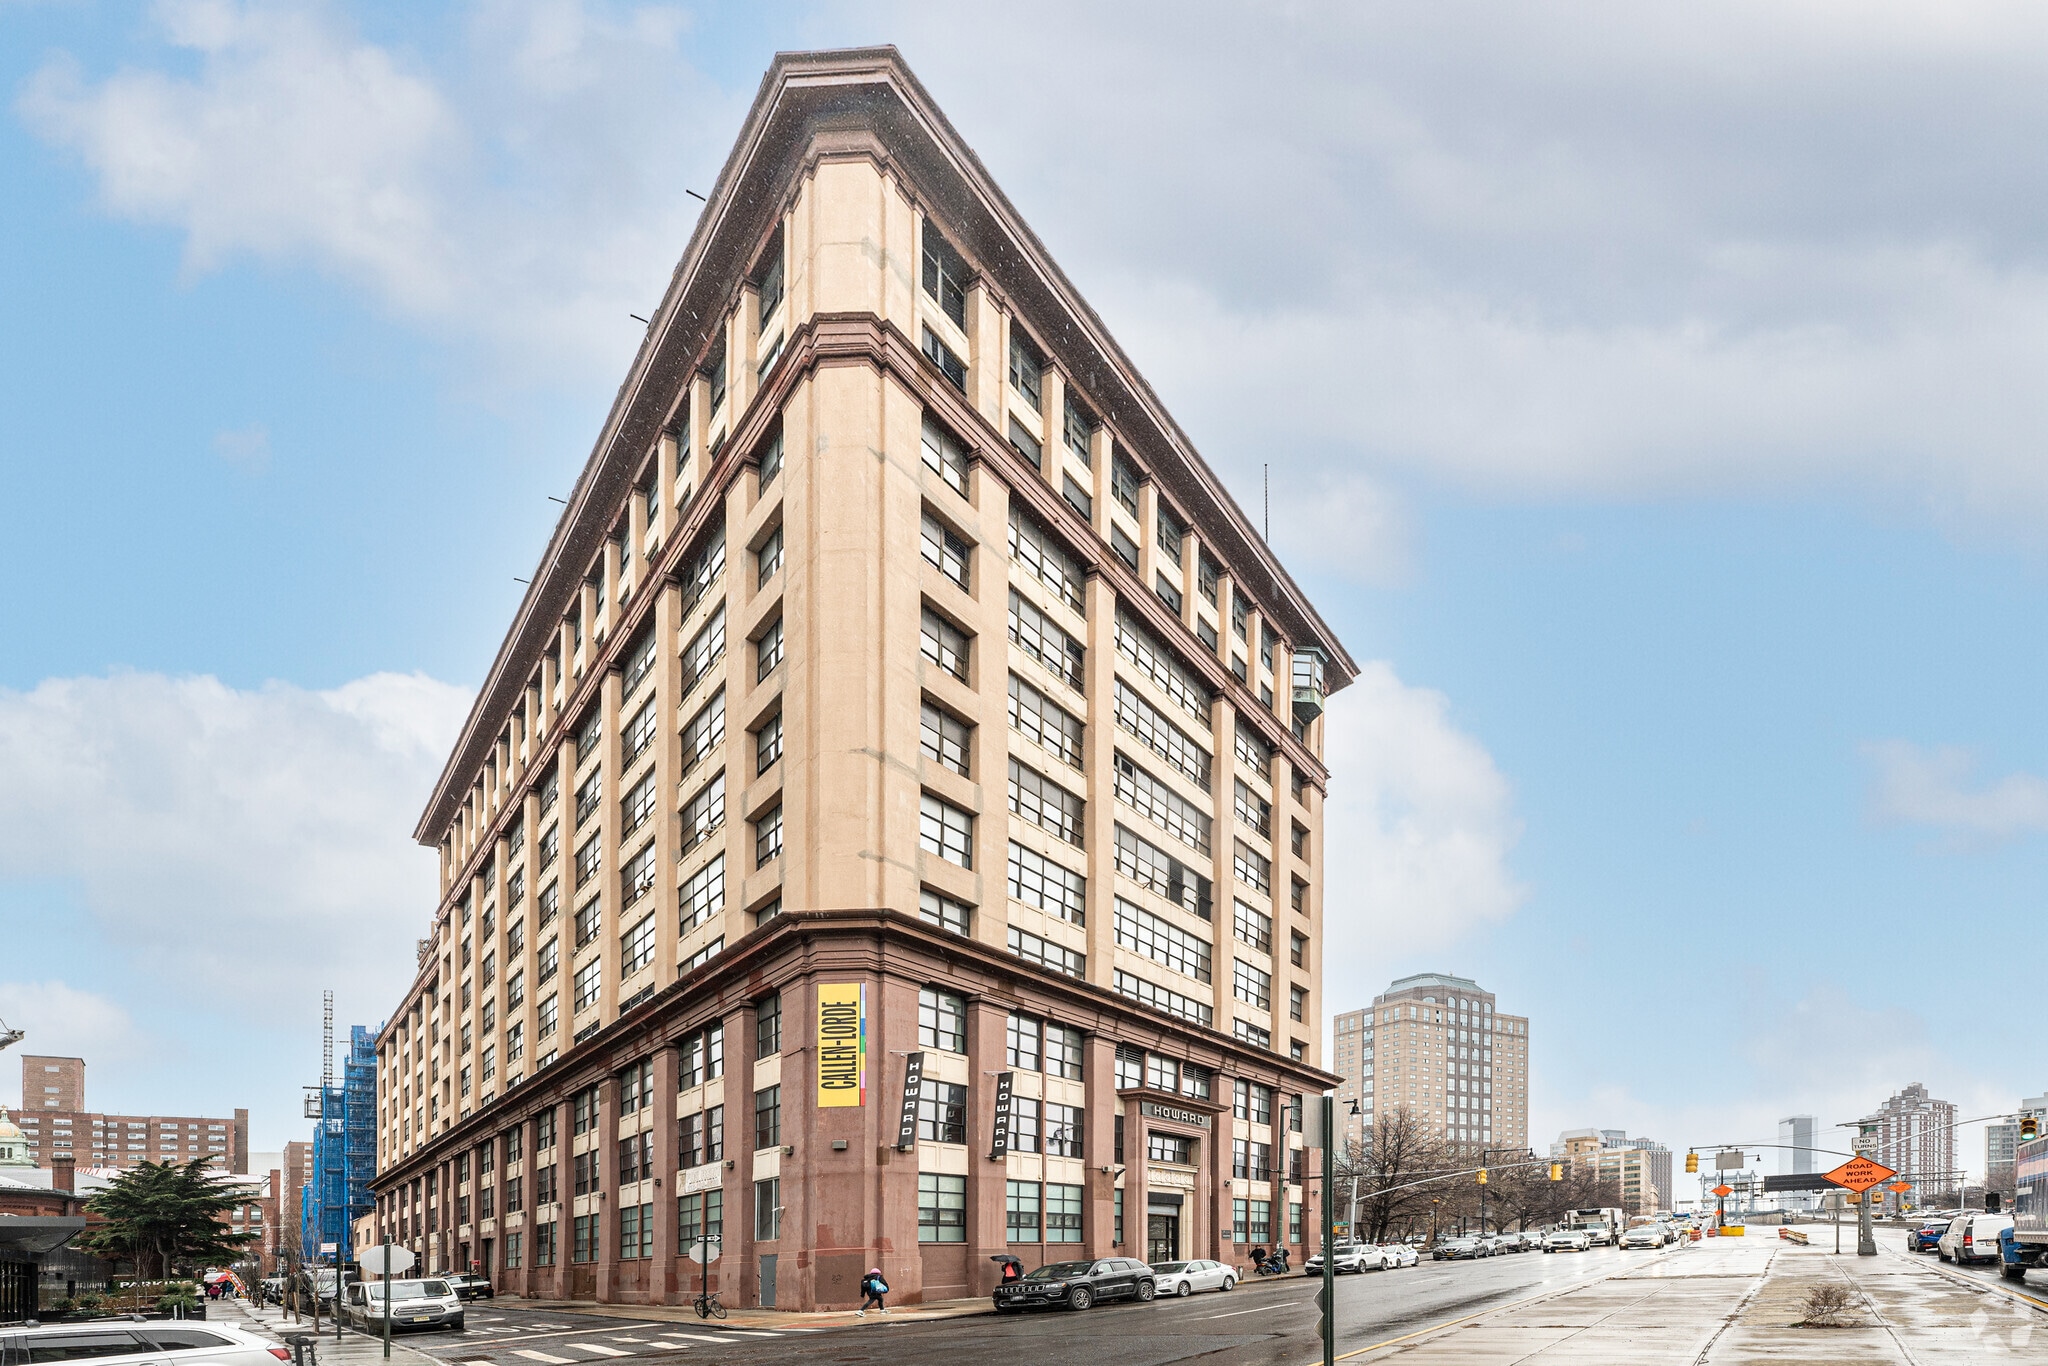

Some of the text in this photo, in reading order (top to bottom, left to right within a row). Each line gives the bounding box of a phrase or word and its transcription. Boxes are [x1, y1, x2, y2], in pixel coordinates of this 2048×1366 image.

[821, 1001, 857, 1090] CALLEN-LORDE
[901, 1062, 920, 1136] HOWARD
[994, 1081, 1009, 1148] HOWARD
[1154, 1105, 1204, 1124] HOWARD
